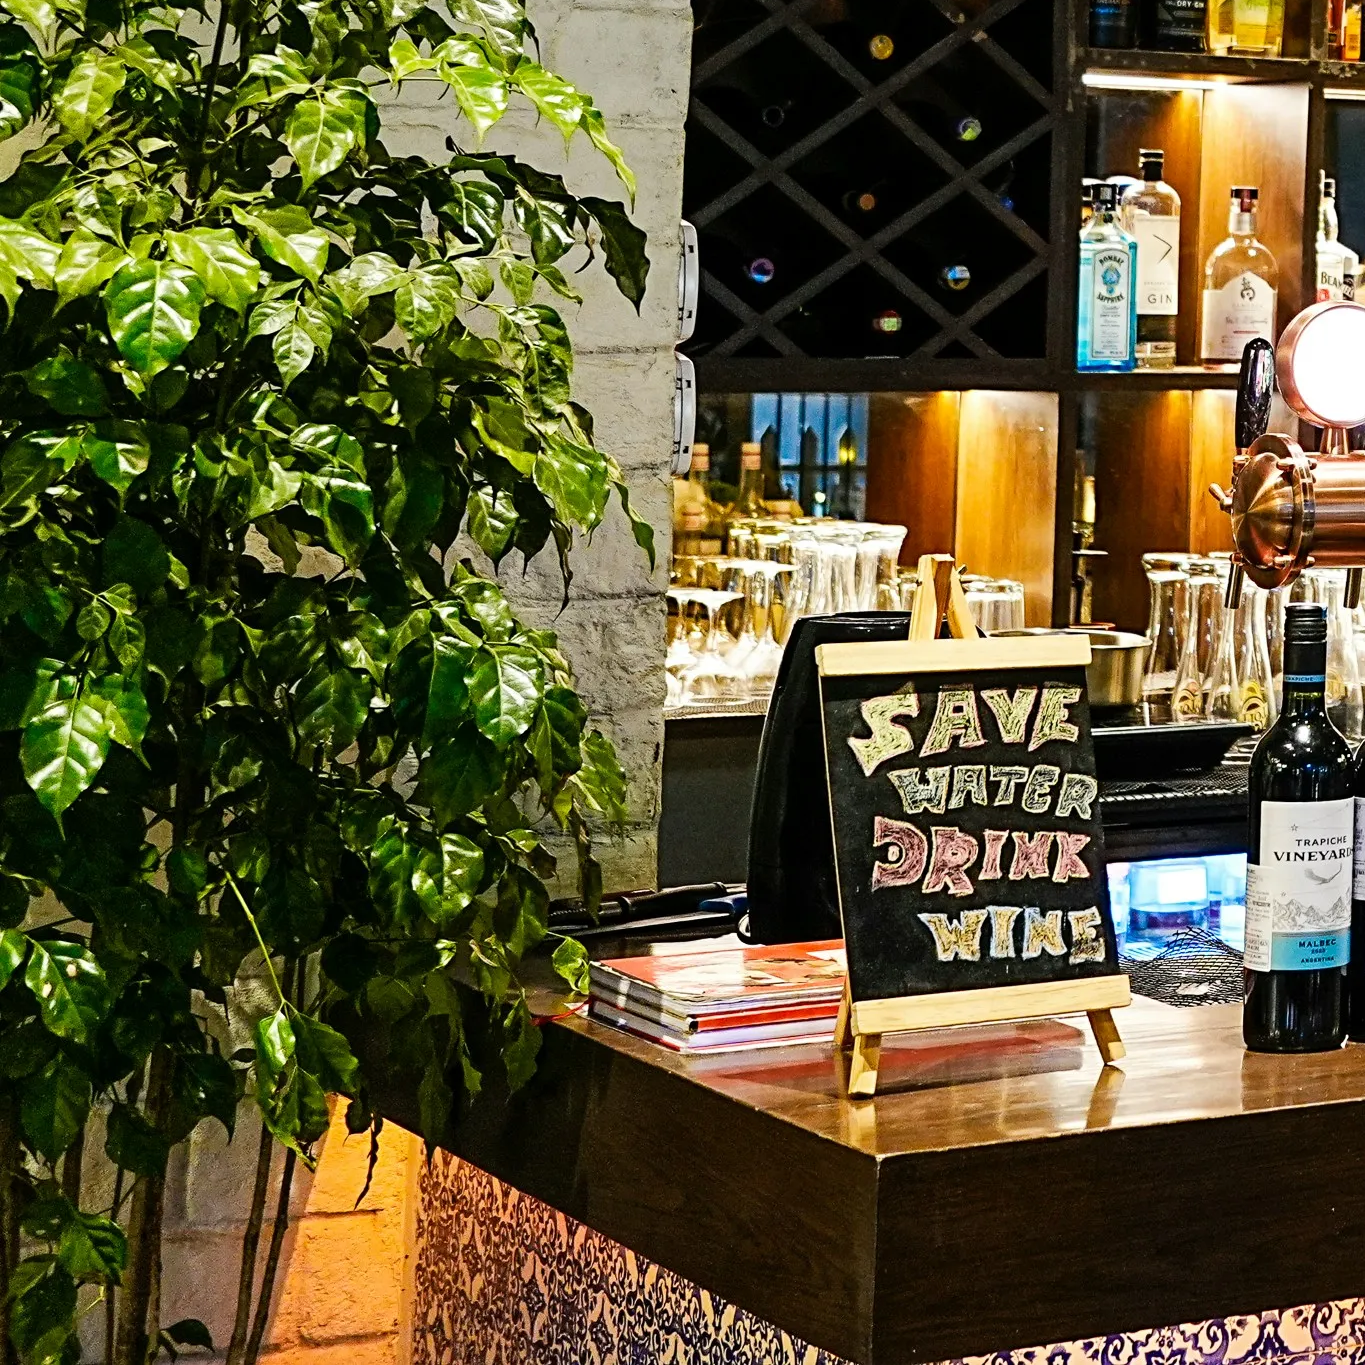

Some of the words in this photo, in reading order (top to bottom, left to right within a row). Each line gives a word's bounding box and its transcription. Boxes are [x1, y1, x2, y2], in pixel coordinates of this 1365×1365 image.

[1147, 293, 1172, 304] GIN
[847, 682, 1082, 776] SAVE
[887, 765, 1098, 820] WATER
[871, 816, 1090, 897] DRINK
[1295, 835, 1347, 847] TRAPICHE
[917, 905, 1106, 964] WINE
[1298, 939, 1337, 949] MALBEC
[1300, 956, 1335, 964] ARGENTINA
